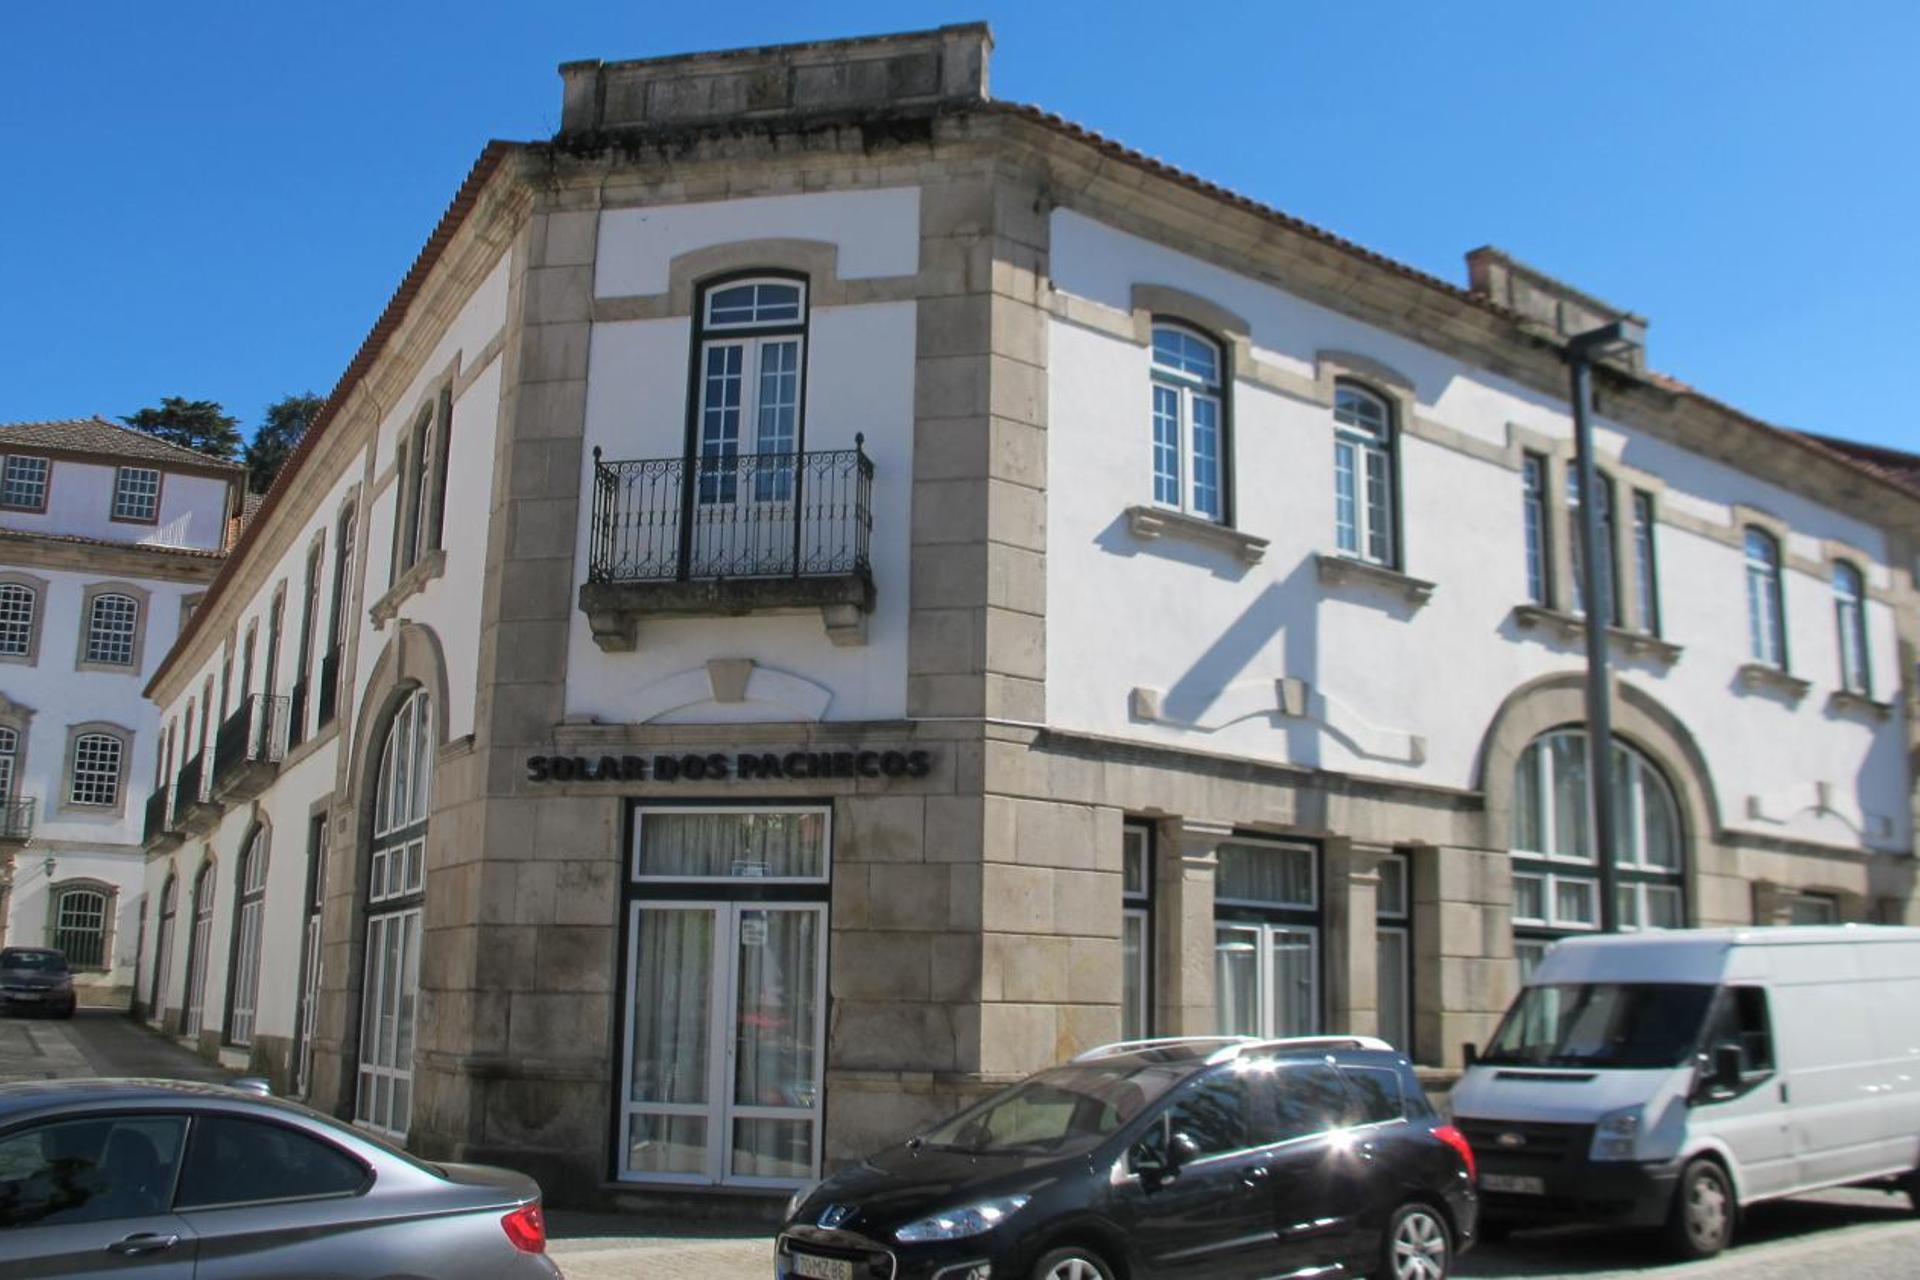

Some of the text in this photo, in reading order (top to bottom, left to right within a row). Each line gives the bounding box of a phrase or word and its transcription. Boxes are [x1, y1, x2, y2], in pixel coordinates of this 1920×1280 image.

[527, 750, 931, 781] SOLAR DOS PACHECOS
